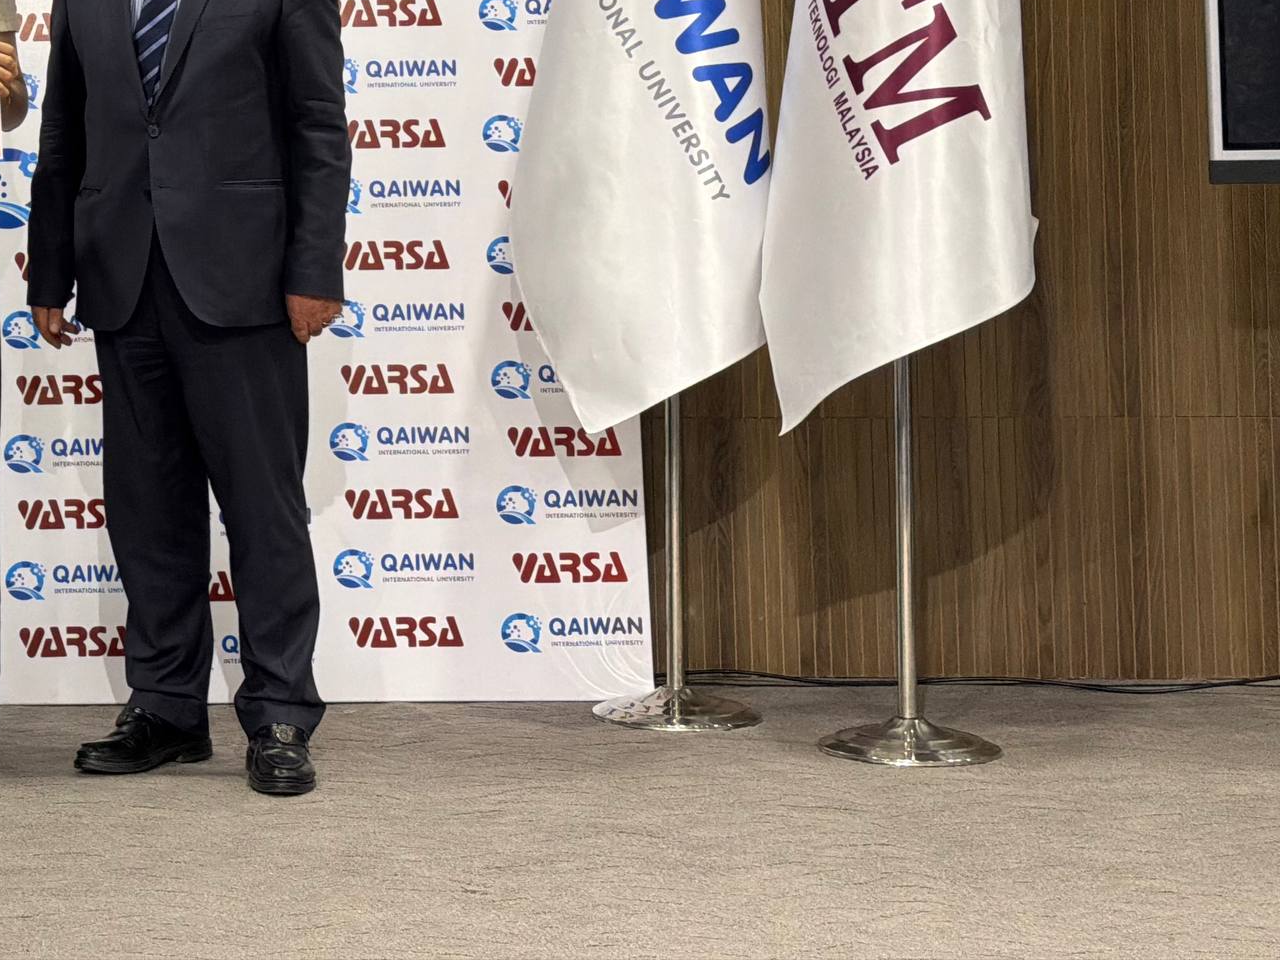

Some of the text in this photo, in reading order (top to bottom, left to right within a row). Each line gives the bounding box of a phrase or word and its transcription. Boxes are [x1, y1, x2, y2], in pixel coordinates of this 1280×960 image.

[366, 59, 456, 77] QAIWAN
[639, 60, 730, 201] UNIVERSITY
[832, 91, 880, 181] MALAYSIA
[369, 179, 460, 198] QAIWAN
[373, 303, 465, 321] QAIWAN
[16, 374, 103, 405] VARS
[341, 364, 454, 395] VARSA
[377, 426, 469, 445] QAIWAN
[507, 427, 622, 457] VARSA
[345, 488, 459, 520] VARSA
[544, 489, 637, 508] QAIWAN
[18, 499, 106, 530] VARS
[53, 565, 121, 584] QAIW
[381, 553, 474, 572] QAIWAN
[512, 552, 628, 584] VARSA
[349, 616, 464, 648] VARSA
[549, 617, 643, 636] QAIWAN
